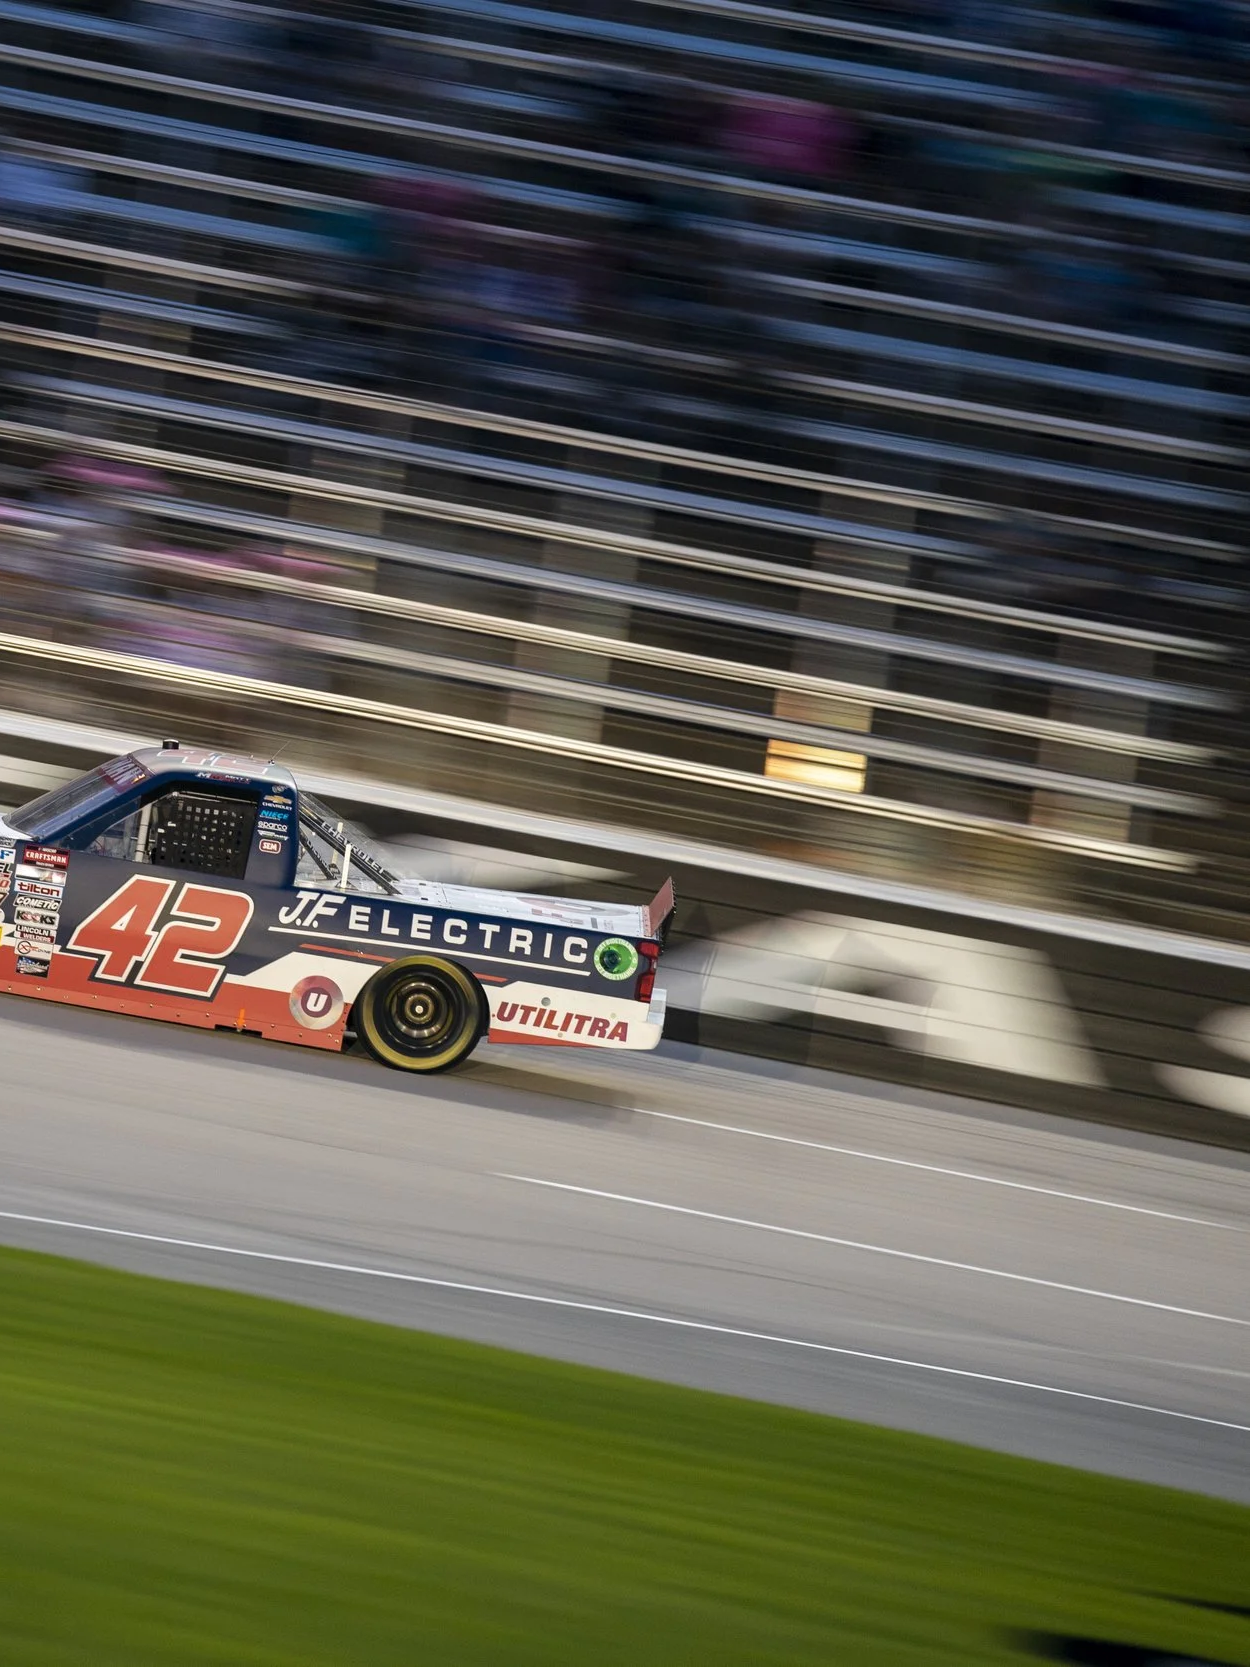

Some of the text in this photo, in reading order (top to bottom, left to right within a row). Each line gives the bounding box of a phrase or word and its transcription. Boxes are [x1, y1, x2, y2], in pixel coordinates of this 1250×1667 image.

[262, 802, 293, 811] CHEVROLET
[260, 810, 290, 820] NIECE
[262, 842, 278, 851] SEM
[25, 851, 67, 864] CRAFTSMAN
[17, 881, 60, 897] tilton
[16, 910, 56, 926] KOOKS
[17, 924, 49, 936] LINCOLN
[66, 874, 254, 998] 42
[348, 904, 589, 965] ELECTRIC
[23, 932, 51, 944] WELDERS
[306, 992, 329, 1013] U
[496, 1001, 629, 1042] UTILITRA
